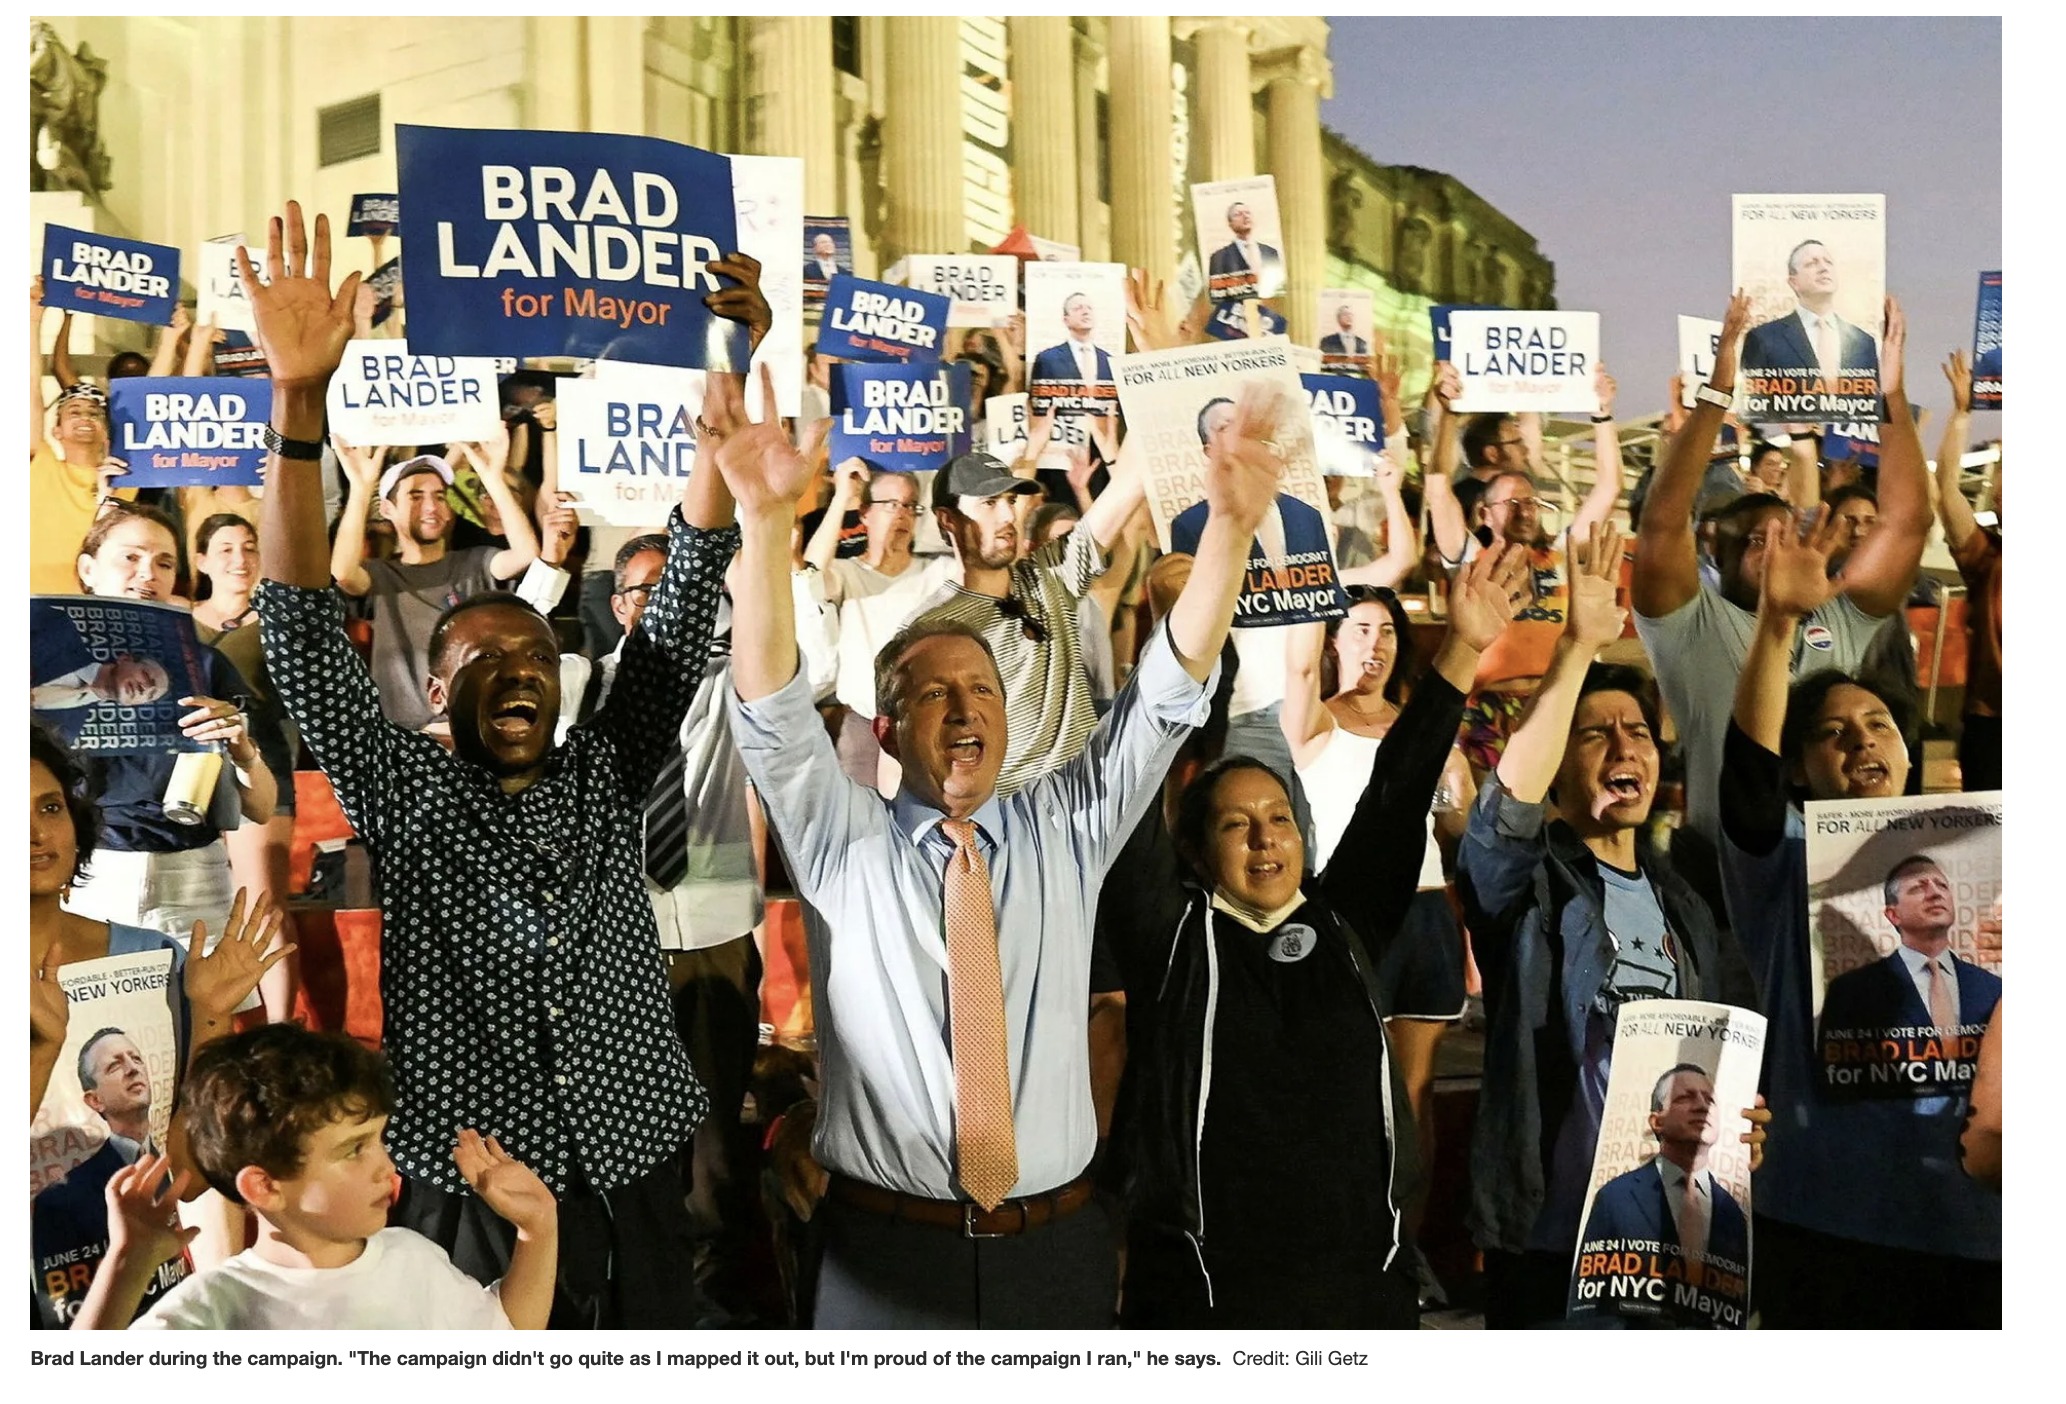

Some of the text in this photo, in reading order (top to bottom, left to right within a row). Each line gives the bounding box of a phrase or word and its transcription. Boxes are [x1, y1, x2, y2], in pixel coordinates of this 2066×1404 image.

[482, 165, 679, 229] BRAD
[1791, 210, 1818, 220] NEW
[1822, 209, 1877, 220] YORKERS
[72, 242, 153, 275] BRAD
[438, 222, 722, 293] LANDER
[53, 258, 169, 299] LANDER
[934, 266, 993, 282] BRAD
[75, 286, 146, 308] for Mayor
[502, 287, 671, 329] for Mayor
[851, 290, 924, 323] BRAD
[831, 307, 936, 349] LANDER
[1486, 326, 1567, 350] BRAD
[870, 337, 913, 357] Mayor
[362, 355, 456, 380] BRAD
[1124, 354, 1287, 386] FOR ALL NEW YORKERS
[1465, 352, 1586, 376] LANDER
[342, 378, 482, 409] LANDER
[864, 380, 950, 408] BRAD
[1743, 378, 1797, 395] BRAD
[145, 394, 247, 421] BRAD
[1773, 395, 1816, 412] NYC
[1820, 395, 1877, 415] Mayor
[607, 402, 697, 439] BRA
[843, 407, 965, 434] LANDER
[1833, 421, 1880, 443] LAN
[124, 421, 268, 450] LANDER
[870, 438, 945, 455] for Mayor
[152, 453, 239, 470] for Mayor
[578, 438, 696, 477] LAND
[1154, 471, 1206, 498] BRA
[1247, 563, 1333, 593] LANDER
[1272, 589, 1336, 613] Mayor
[85, 607, 110, 662] BRAD
[1817, 820, 1850, 835] FOR
[1854, 819, 1884, 834] ALL
[1886, 817, 1926, 831] NEW
[62, 971, 107, 988] FORDABLE
[65, 973, 171, 1003] NEW YORKERS
[1665, 1023, 1703, 1038] NEW
[1883, 1027, 1916, 1039] VOTE
[1918, 1026, 1944, 1038] FOR
[1826, 1037, 1981, 1063] BRAD LAND
[1826, 1064, 1862, 1085] for
[1870, 1061, 1927, 1084] NYC
[42, 1245, 100, 1271] JUNE 24
[1583, 1241, 1605, 1254] JUNE
[1606, 1239, 1620, 1251] 24
[1627, 1239, 1660, 1253] VOTE
[46, 1262, 92, 1298] BR
[1579, 1252, 1747, 1299] BRAD LANDER
[54, 1255, 187, 1324] fo Mayor
[1577, 1275, 1743, 1326] for NYC Mayor
